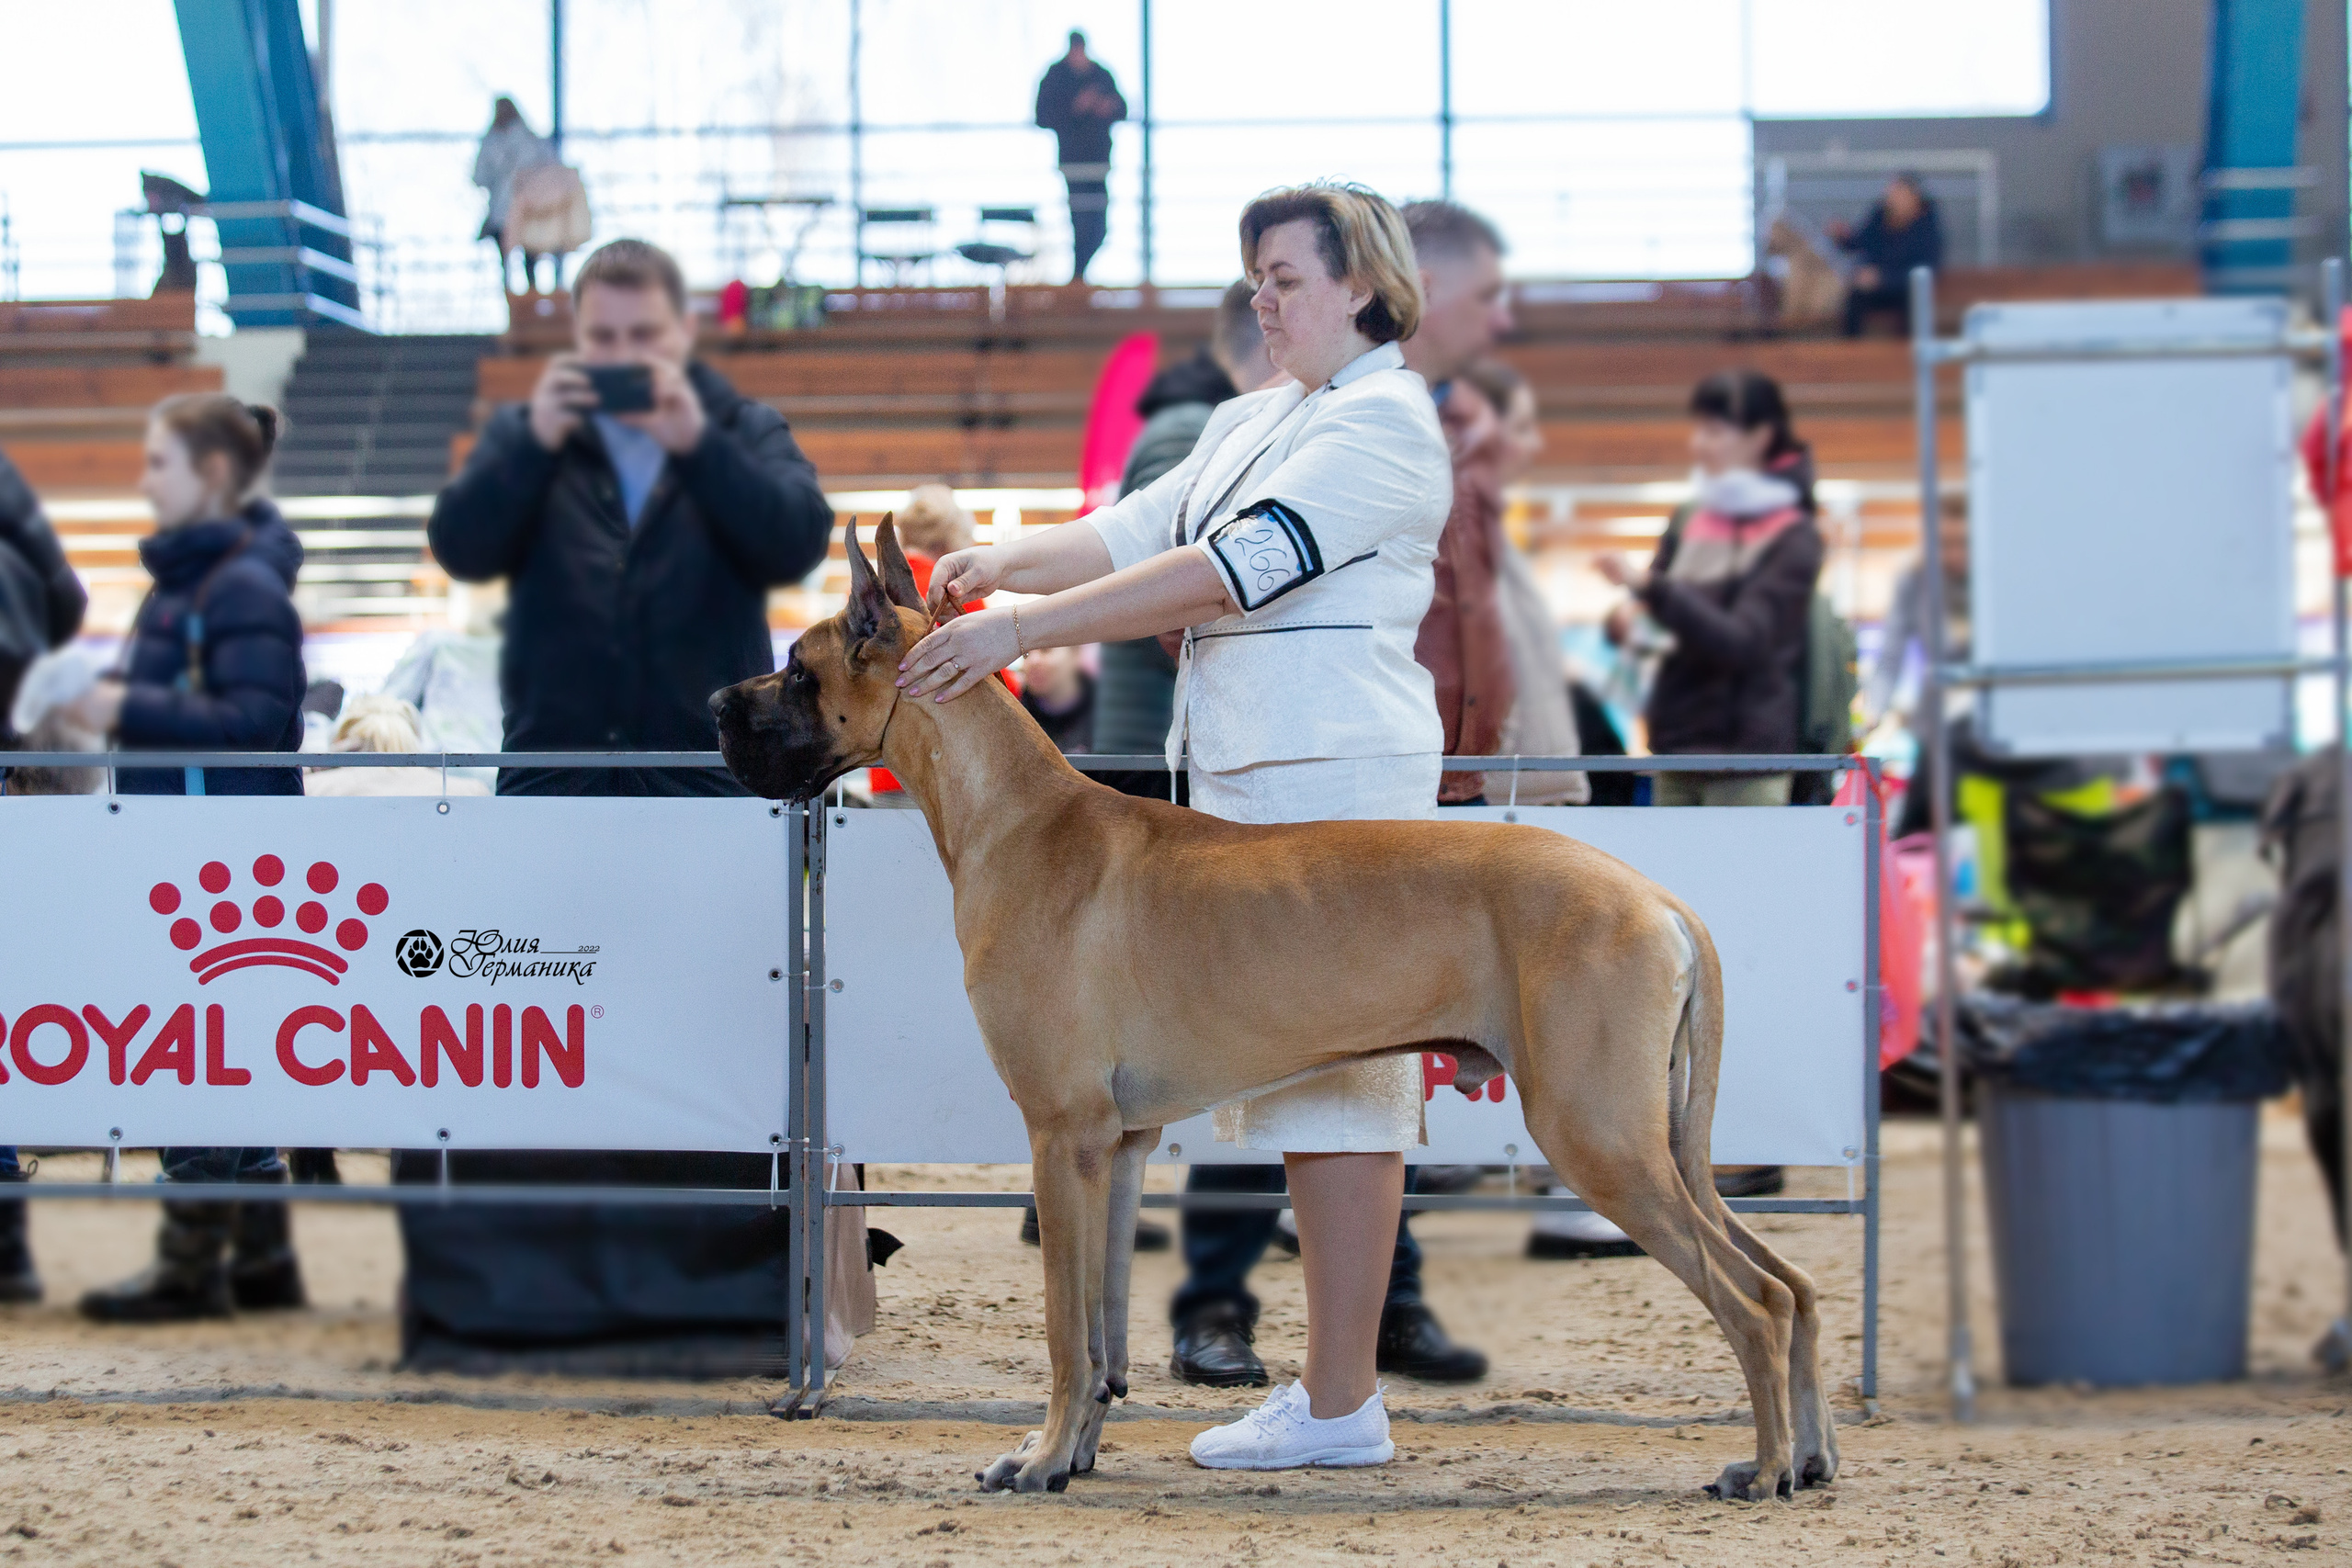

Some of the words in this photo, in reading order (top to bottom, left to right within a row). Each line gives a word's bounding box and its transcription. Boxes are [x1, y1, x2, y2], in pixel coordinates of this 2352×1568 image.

[1234, 529, 1291, 592] 266
[0, 1003, 252, 1086] OYAL
[276, 1003, 585, 1089] CANIN
